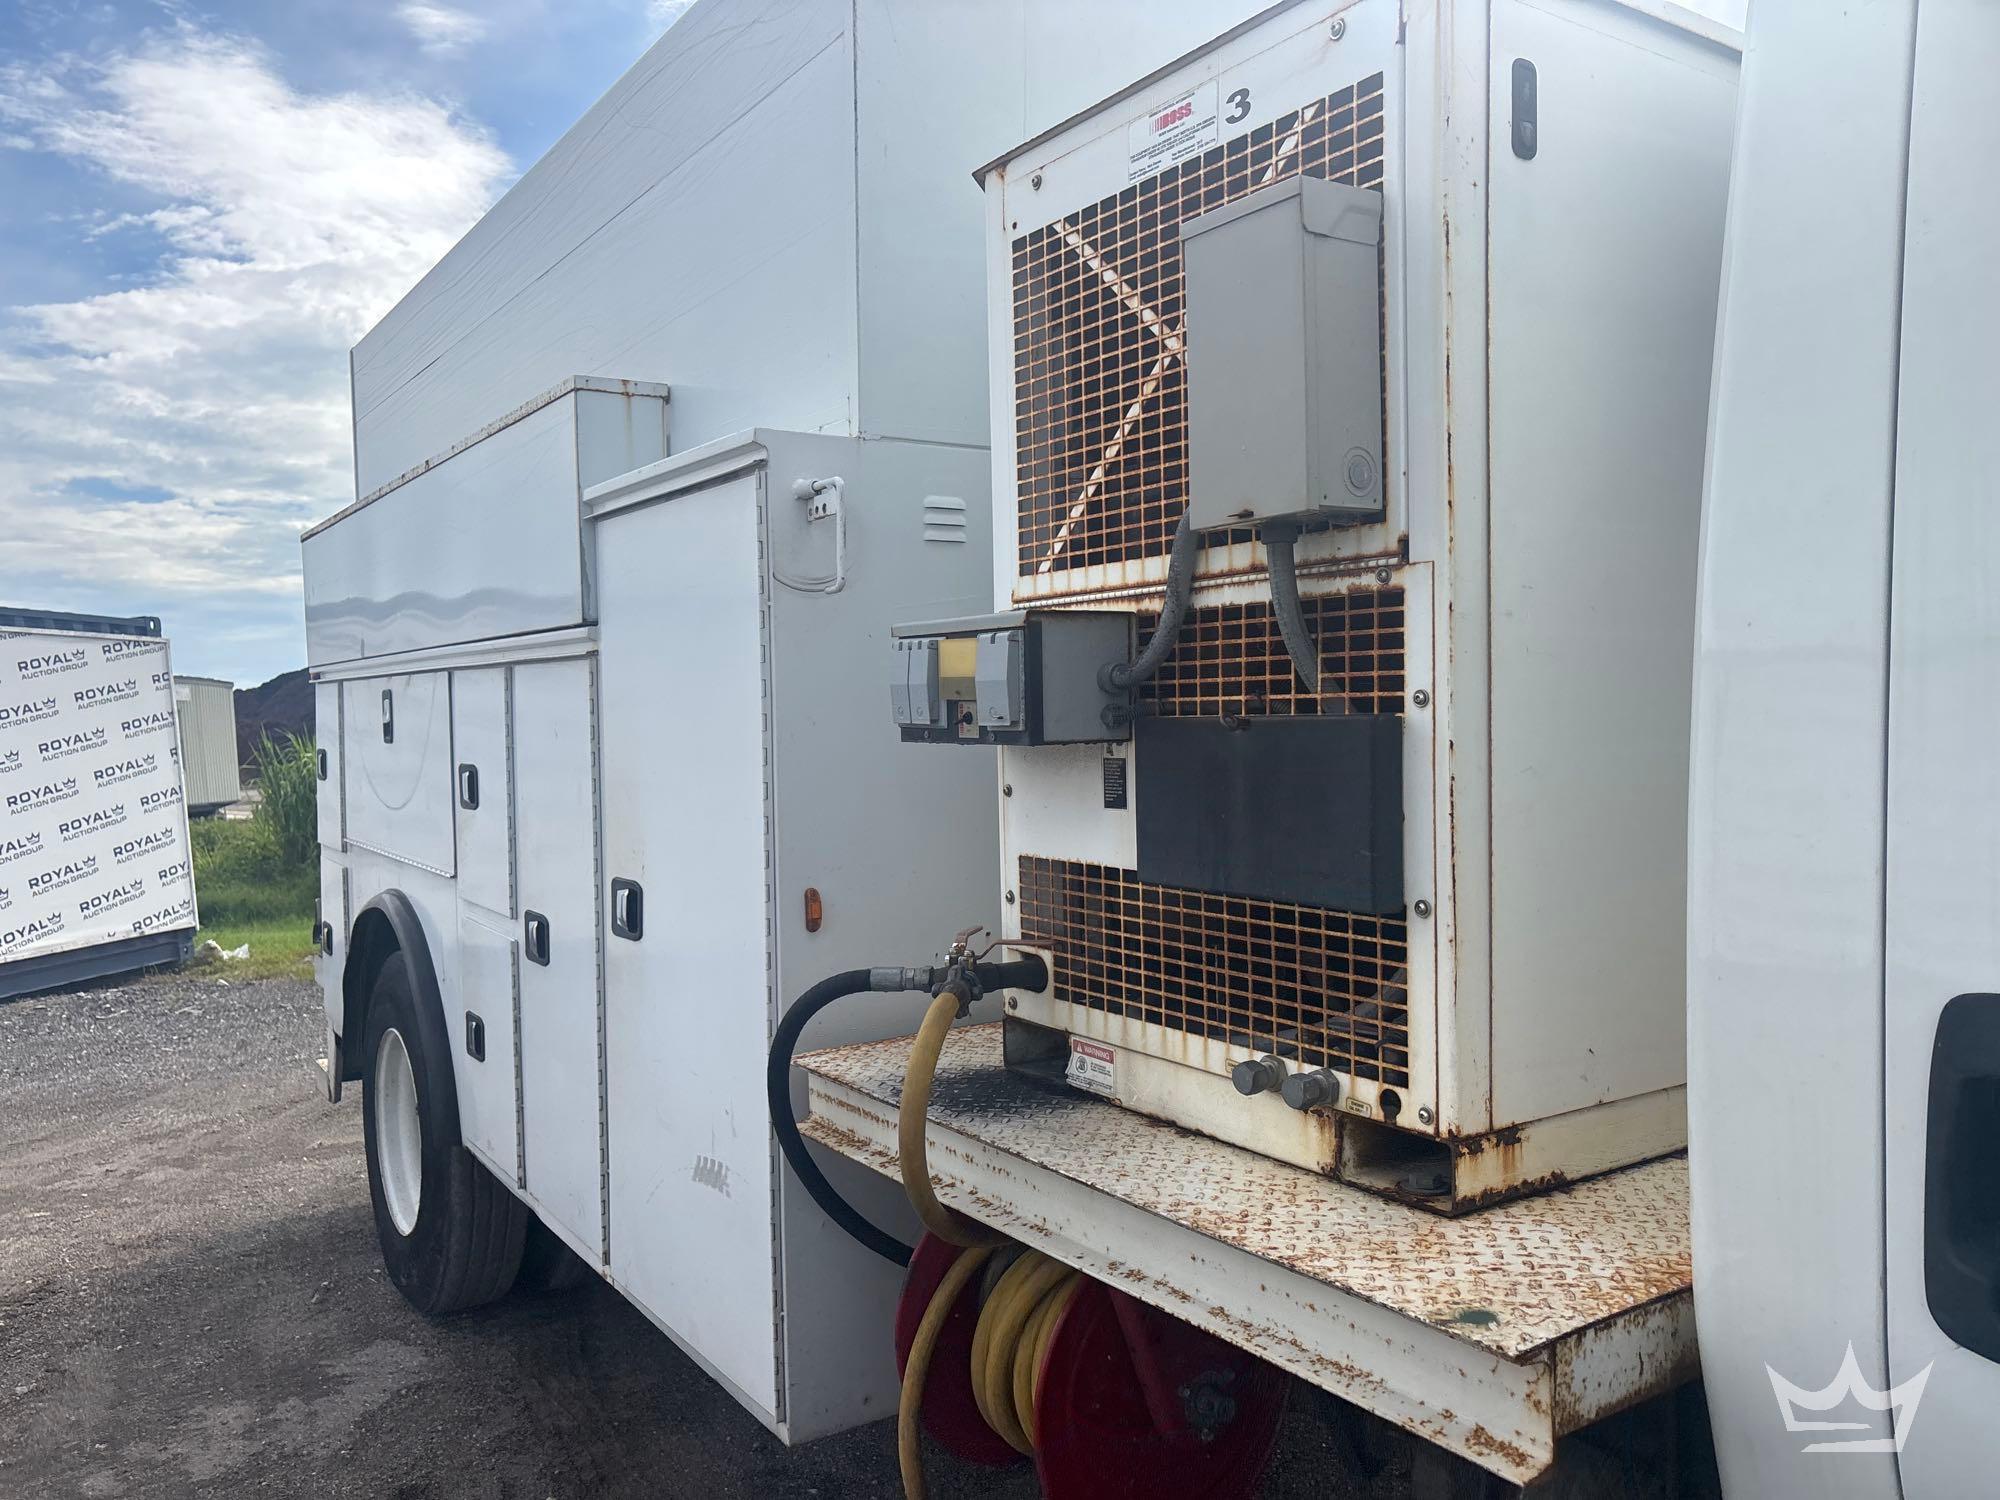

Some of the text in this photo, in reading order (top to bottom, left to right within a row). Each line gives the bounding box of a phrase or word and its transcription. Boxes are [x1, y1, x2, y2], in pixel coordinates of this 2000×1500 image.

[1226, 88, 1251, 124] 3
[18, 653, 72, 672] ROYAL
[106, 646, 164, 663] AUCTION GROUP
[21, 661, 88, 680] AUCTION GROUP
[74, 682, 125, 702] ROYAL
[78, 691, 139, 710] AUCTION GROUP
[0, 702, 43, 720] OYAL
[30, 710, 59, 722] GROUP
[121, 712, 168, 732] ROYAL
[38, 732, 92, 754] ROYAL
[124, 726, 157, 739] AUCTION
[42, 739, 108, 762] AUCTION GROUP
[94, 759, 143, 780] ROYAL
[97, 765, 158, 789] AUCTION GROUP
[6, 783, 63, 807] ROYAL
[10, 789, 79, 816] AUCTION GROUP
[143, 800, 175, 814] AUCTION
[59, 809, 112, 834] ROYAL
[63, 816, 127, 843] AUCTION GROUP
[13, 844, 44, 860] GROUP
[113, 833, 162, 857] ROYAL
[116, 838, 176, 864] AUCTION GROUP
[28, 862, 83, 889] ROYAL
[32, 867, 99, 897] AUCTION GROUP
[158, 861, 189, 880] ROY
[80, 886, 130, 913] ROYAL
[83, 890, 145, 920] AUCTION GROUP
[132, 905, 180, 932] ROYAL
[0, 920, 48, 947] OYAL
[0, 924, 65, 956] UCTION GROUP
[1084, 1046, 1110, 1060] WARNING
